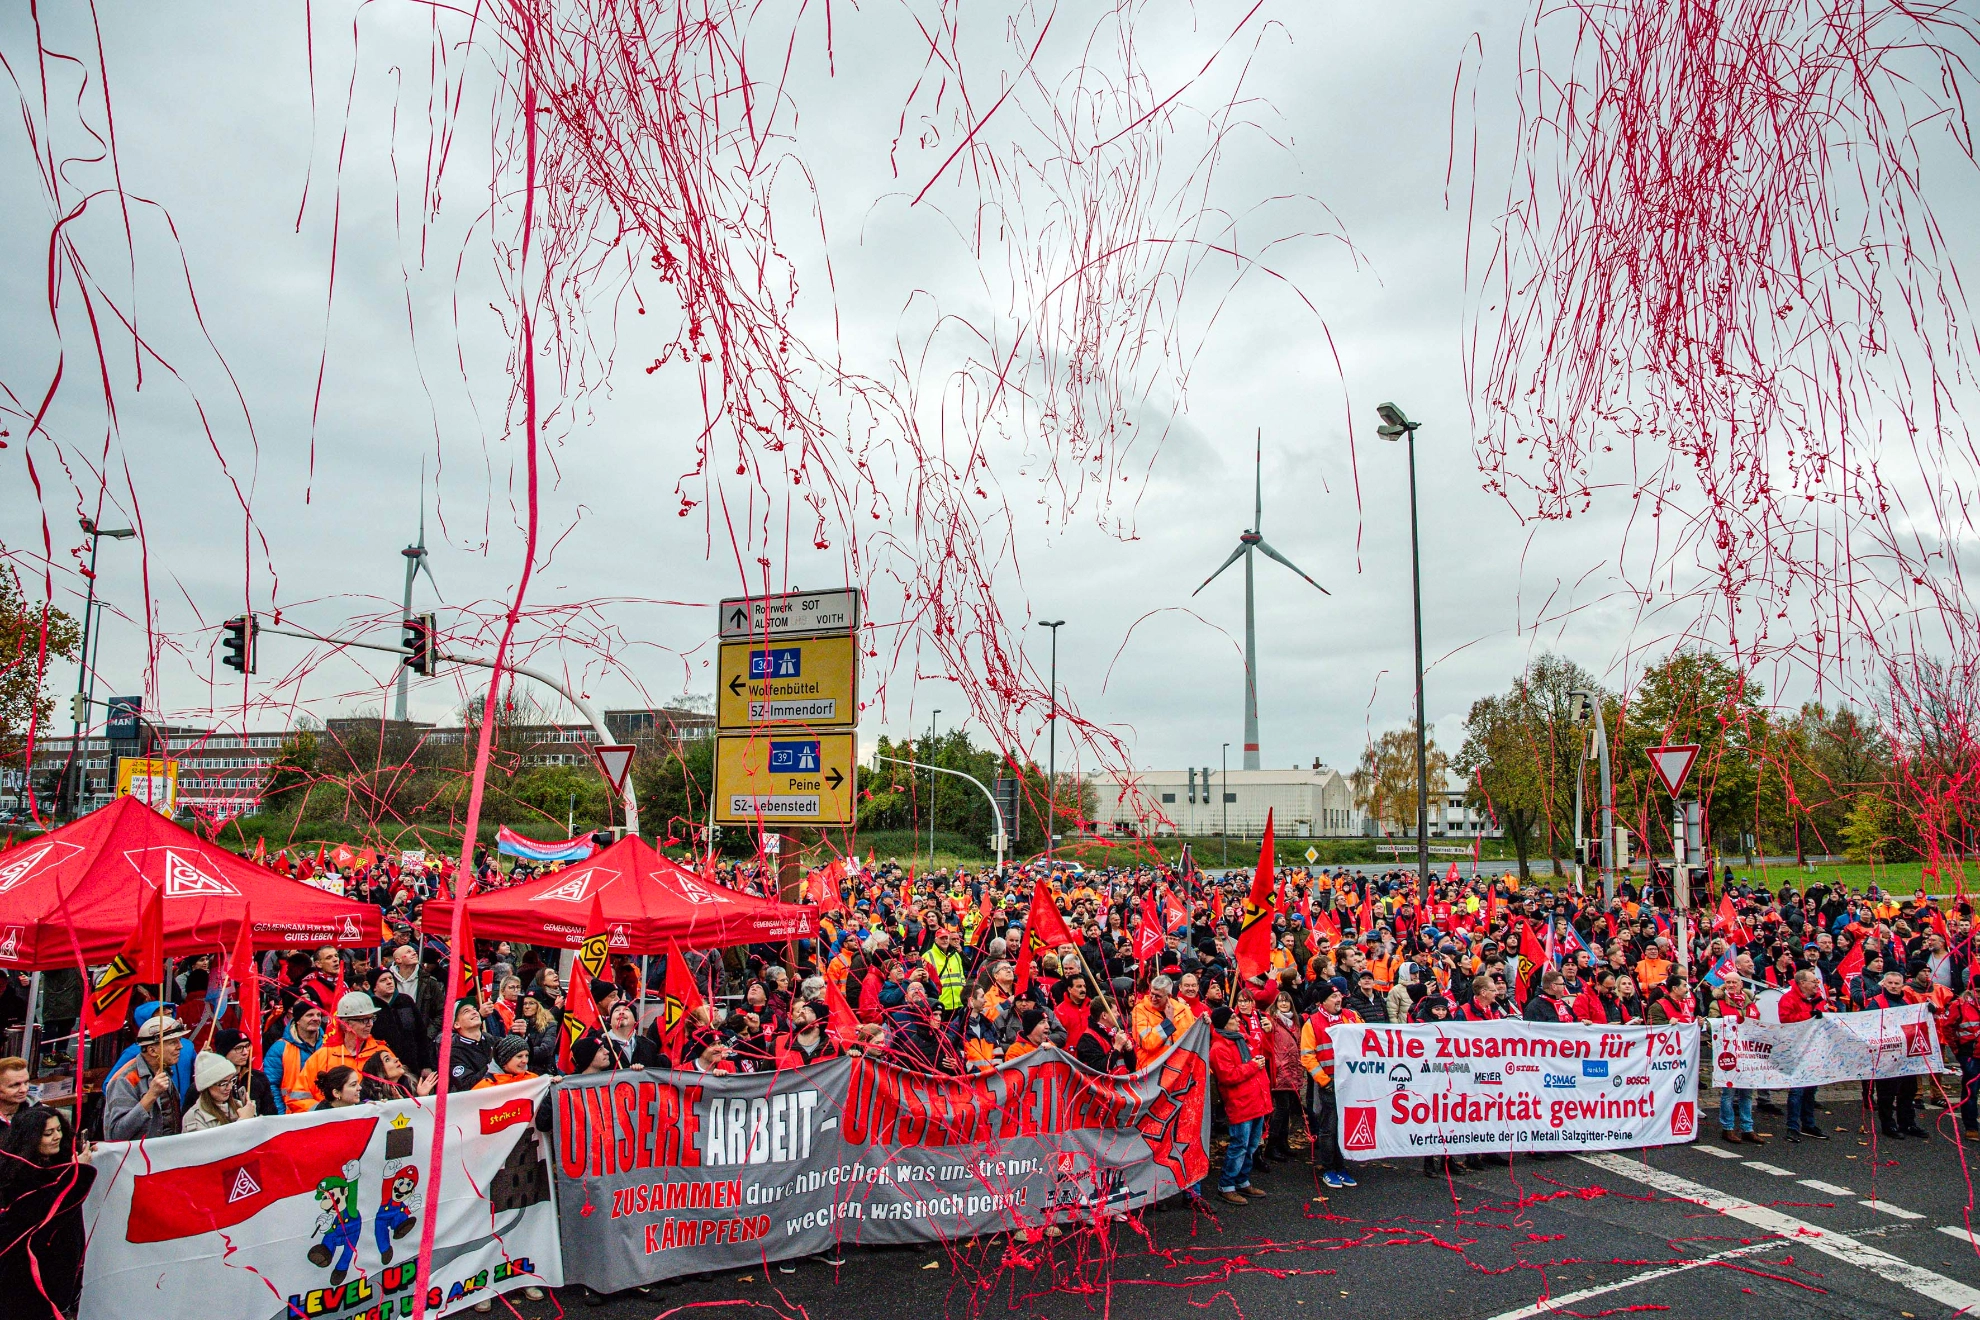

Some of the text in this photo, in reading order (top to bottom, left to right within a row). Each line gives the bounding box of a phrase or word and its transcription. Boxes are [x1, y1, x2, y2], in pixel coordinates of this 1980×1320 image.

[802, 600, 820, 610] SOT
[755, 617, 788, 628] ALSTOM
[816, 613, 844, 624] VOITH
[749, 682, 819, 696] Wolfenbüttel
[751, 703, 833, 717] SZ-Immendorf
[112, 718, 131, 726] MAN
[778, 753, 787, 762] 39
[789, 779, 820, 790] Peine
[734, 799, 817, 812] SZ-Lebenstedt
[253, 923, 305, 932] GEMEINSAM
[543, 923, 581, 933] GEMEINSAM
[284, 932, 333, 941] GUTES LEBEN
[566, 934, 585, 943] GUTES
[1361, 1028, 1425, 1058] Alle
[1436, 1037, 1591, 1059] zusammen
[1600, 1033, 1636, 1058] für
[1722, 1039, 1730, 1050] 7
[1742, 1040, 1773, 1053] MEHR
[1346, 1061, 1385, 1074] VOITH
[1432, 1063, 1470, 1073] MAGNA
[1652, 1060, 1687, 1070] ALSTOM
[1474, 1072, 1501, 1081] MEYER
[1552, 1075, 1576, 1085] SMAG
[1626, 1076, 1650, 1085] BOSCH
[1391, 1090, 1655, 1128] Solidarität gewinnt!
[558, 1081, 704, 1179] UNSERE
[843, 1055, 998, 1147] UNSERE
[1410, 1129, 1633, 1145] Vertrauensleute der IG Metall Salzgitter-Peine
[611, 1180, 742, 1219] ZUSAMMEN
[746, 1162, 894, 1205] durchbrechen,
[897, 1164, 935, 1183] was
[940, 1164, 974, 1181] uns
[978, 1157, 1043, 1178] trennt,
[645, 1214, 771, 1255] KÄMPFEND
[871, 1201, 912, 1220] was
[915, 1193, 963, 1218] noch
[287, 1275, 373, 1319] LEVEL
[382, 1258, 418, 1295] UP
[400, 1286, 443, 1319] US
[447, 1269, 488, 1303] ANS
[494, 1257, 536, 1284] ZIEL
